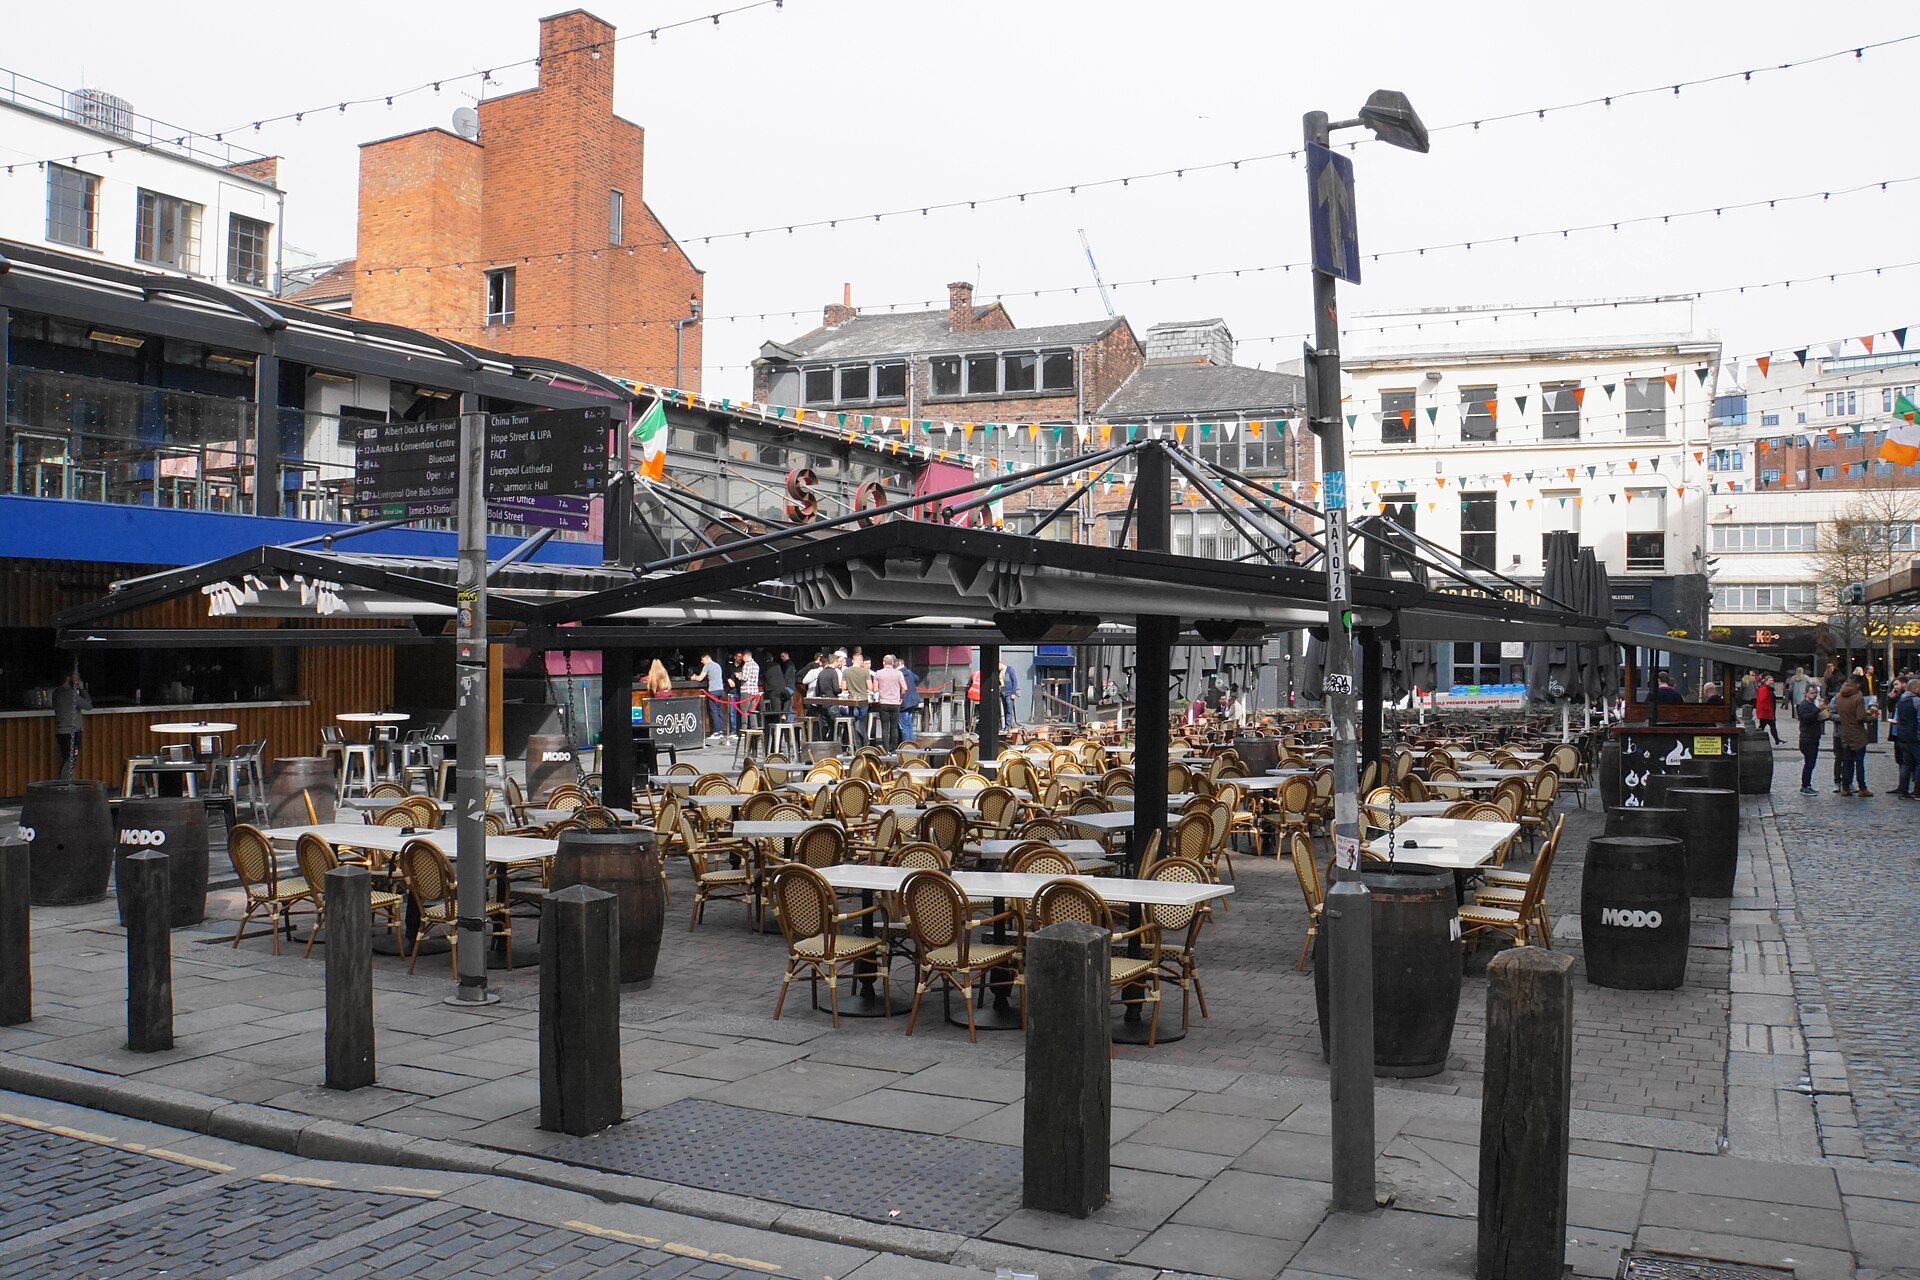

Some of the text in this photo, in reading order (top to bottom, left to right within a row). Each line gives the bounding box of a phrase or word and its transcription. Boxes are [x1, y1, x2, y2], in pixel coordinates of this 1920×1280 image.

[491, 410, 588, 426] China Town 6
[385, 421, 456, 436] Albert Dock & Pier Head
[490, 430, 552, 444] Hope Street & LIPA
[376, 444, 393, 453] Arena
[394, 442, 400, 452] &
[401, 440, 434, 451] Convention
[436, 438, 455, 448] Centre
[428, 454, 455, 463] Bluecoat
[490, 450, 506, 459] FACT
[490, 466, 520, 477] Liverpool
[520, 464, 552, 474] Cathedral
[406, 488, 418, 497] One
[420, 488, 430, 496] Bus
[432, 486, 453, 495] Station
[534, 480, 548, 490] Hall
[408, 506, 425, 517] James
[426, 505, 432, 514] St
[433, 504, 451, 514] Statio
[488, 509, 502, 519] Bold
[504, 511, 524, 522] Street
[656, 712, 696, 734] SOHO
[542, 752, 572, 762] MODO
[120, 829, 165, 845] MODO
[1601, 907, 1662, 928] MODO
